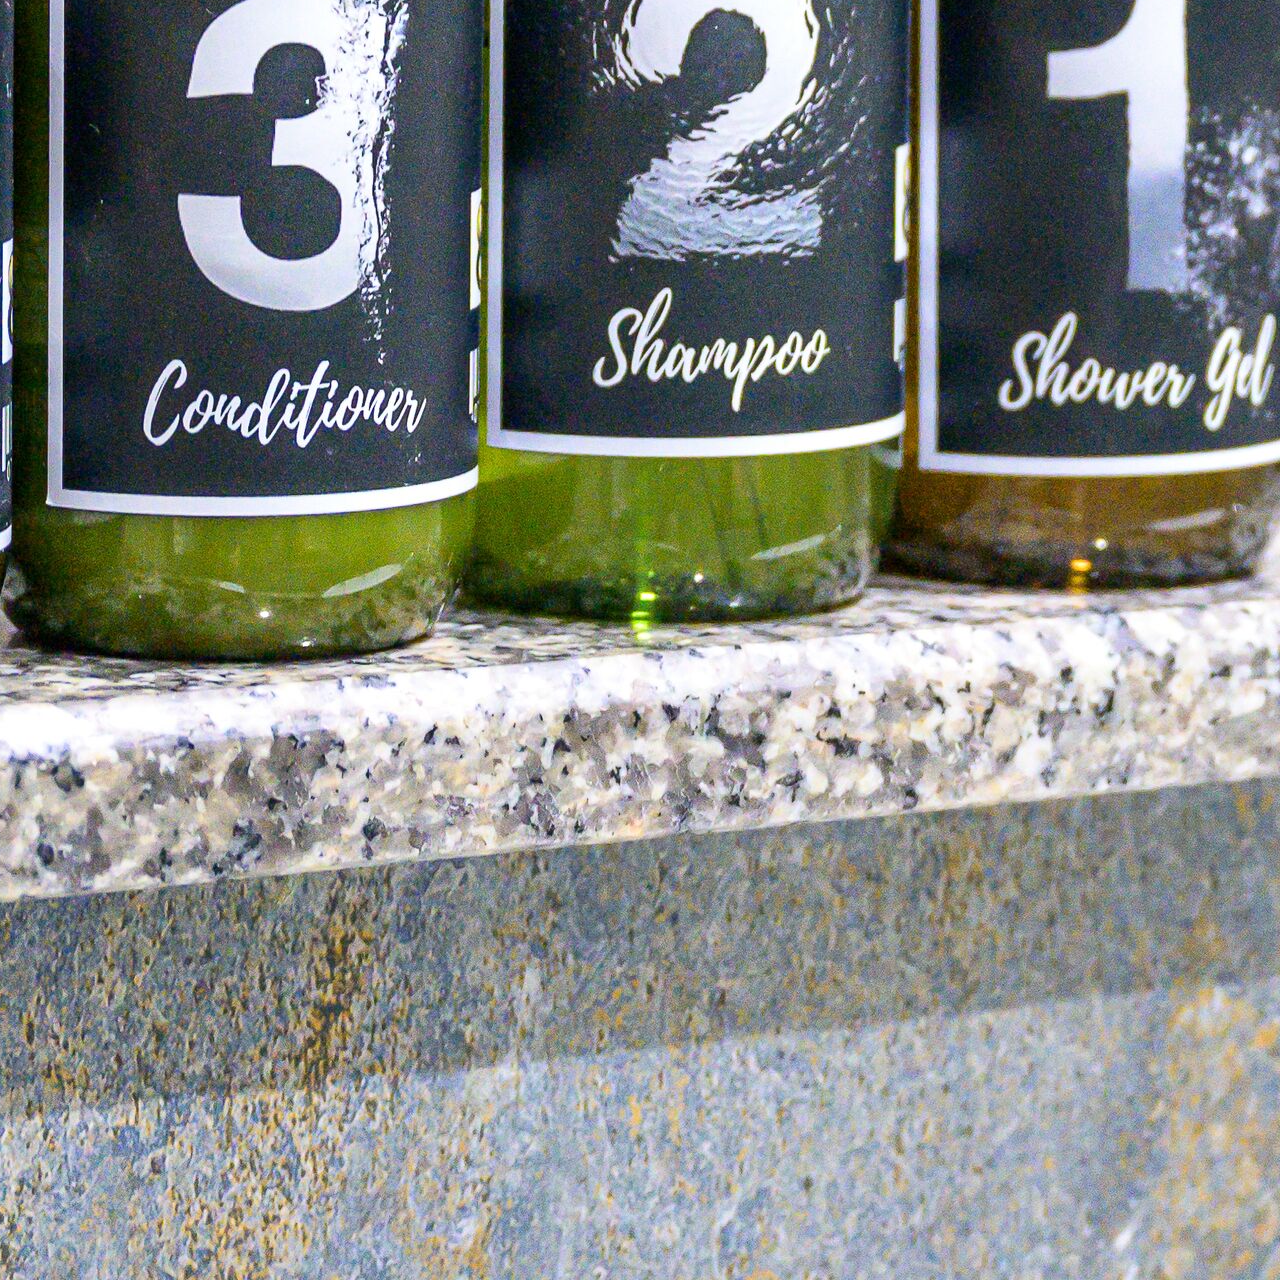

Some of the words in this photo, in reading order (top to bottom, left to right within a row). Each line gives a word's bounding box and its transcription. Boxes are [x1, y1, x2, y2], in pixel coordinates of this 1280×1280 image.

[142, 358, 428, 449] Conditioner
[592, 286, 832, 413] Shampoo
[998, 311, 1197, 411] Shower
[1202, 314, 1277, 432] Gel
